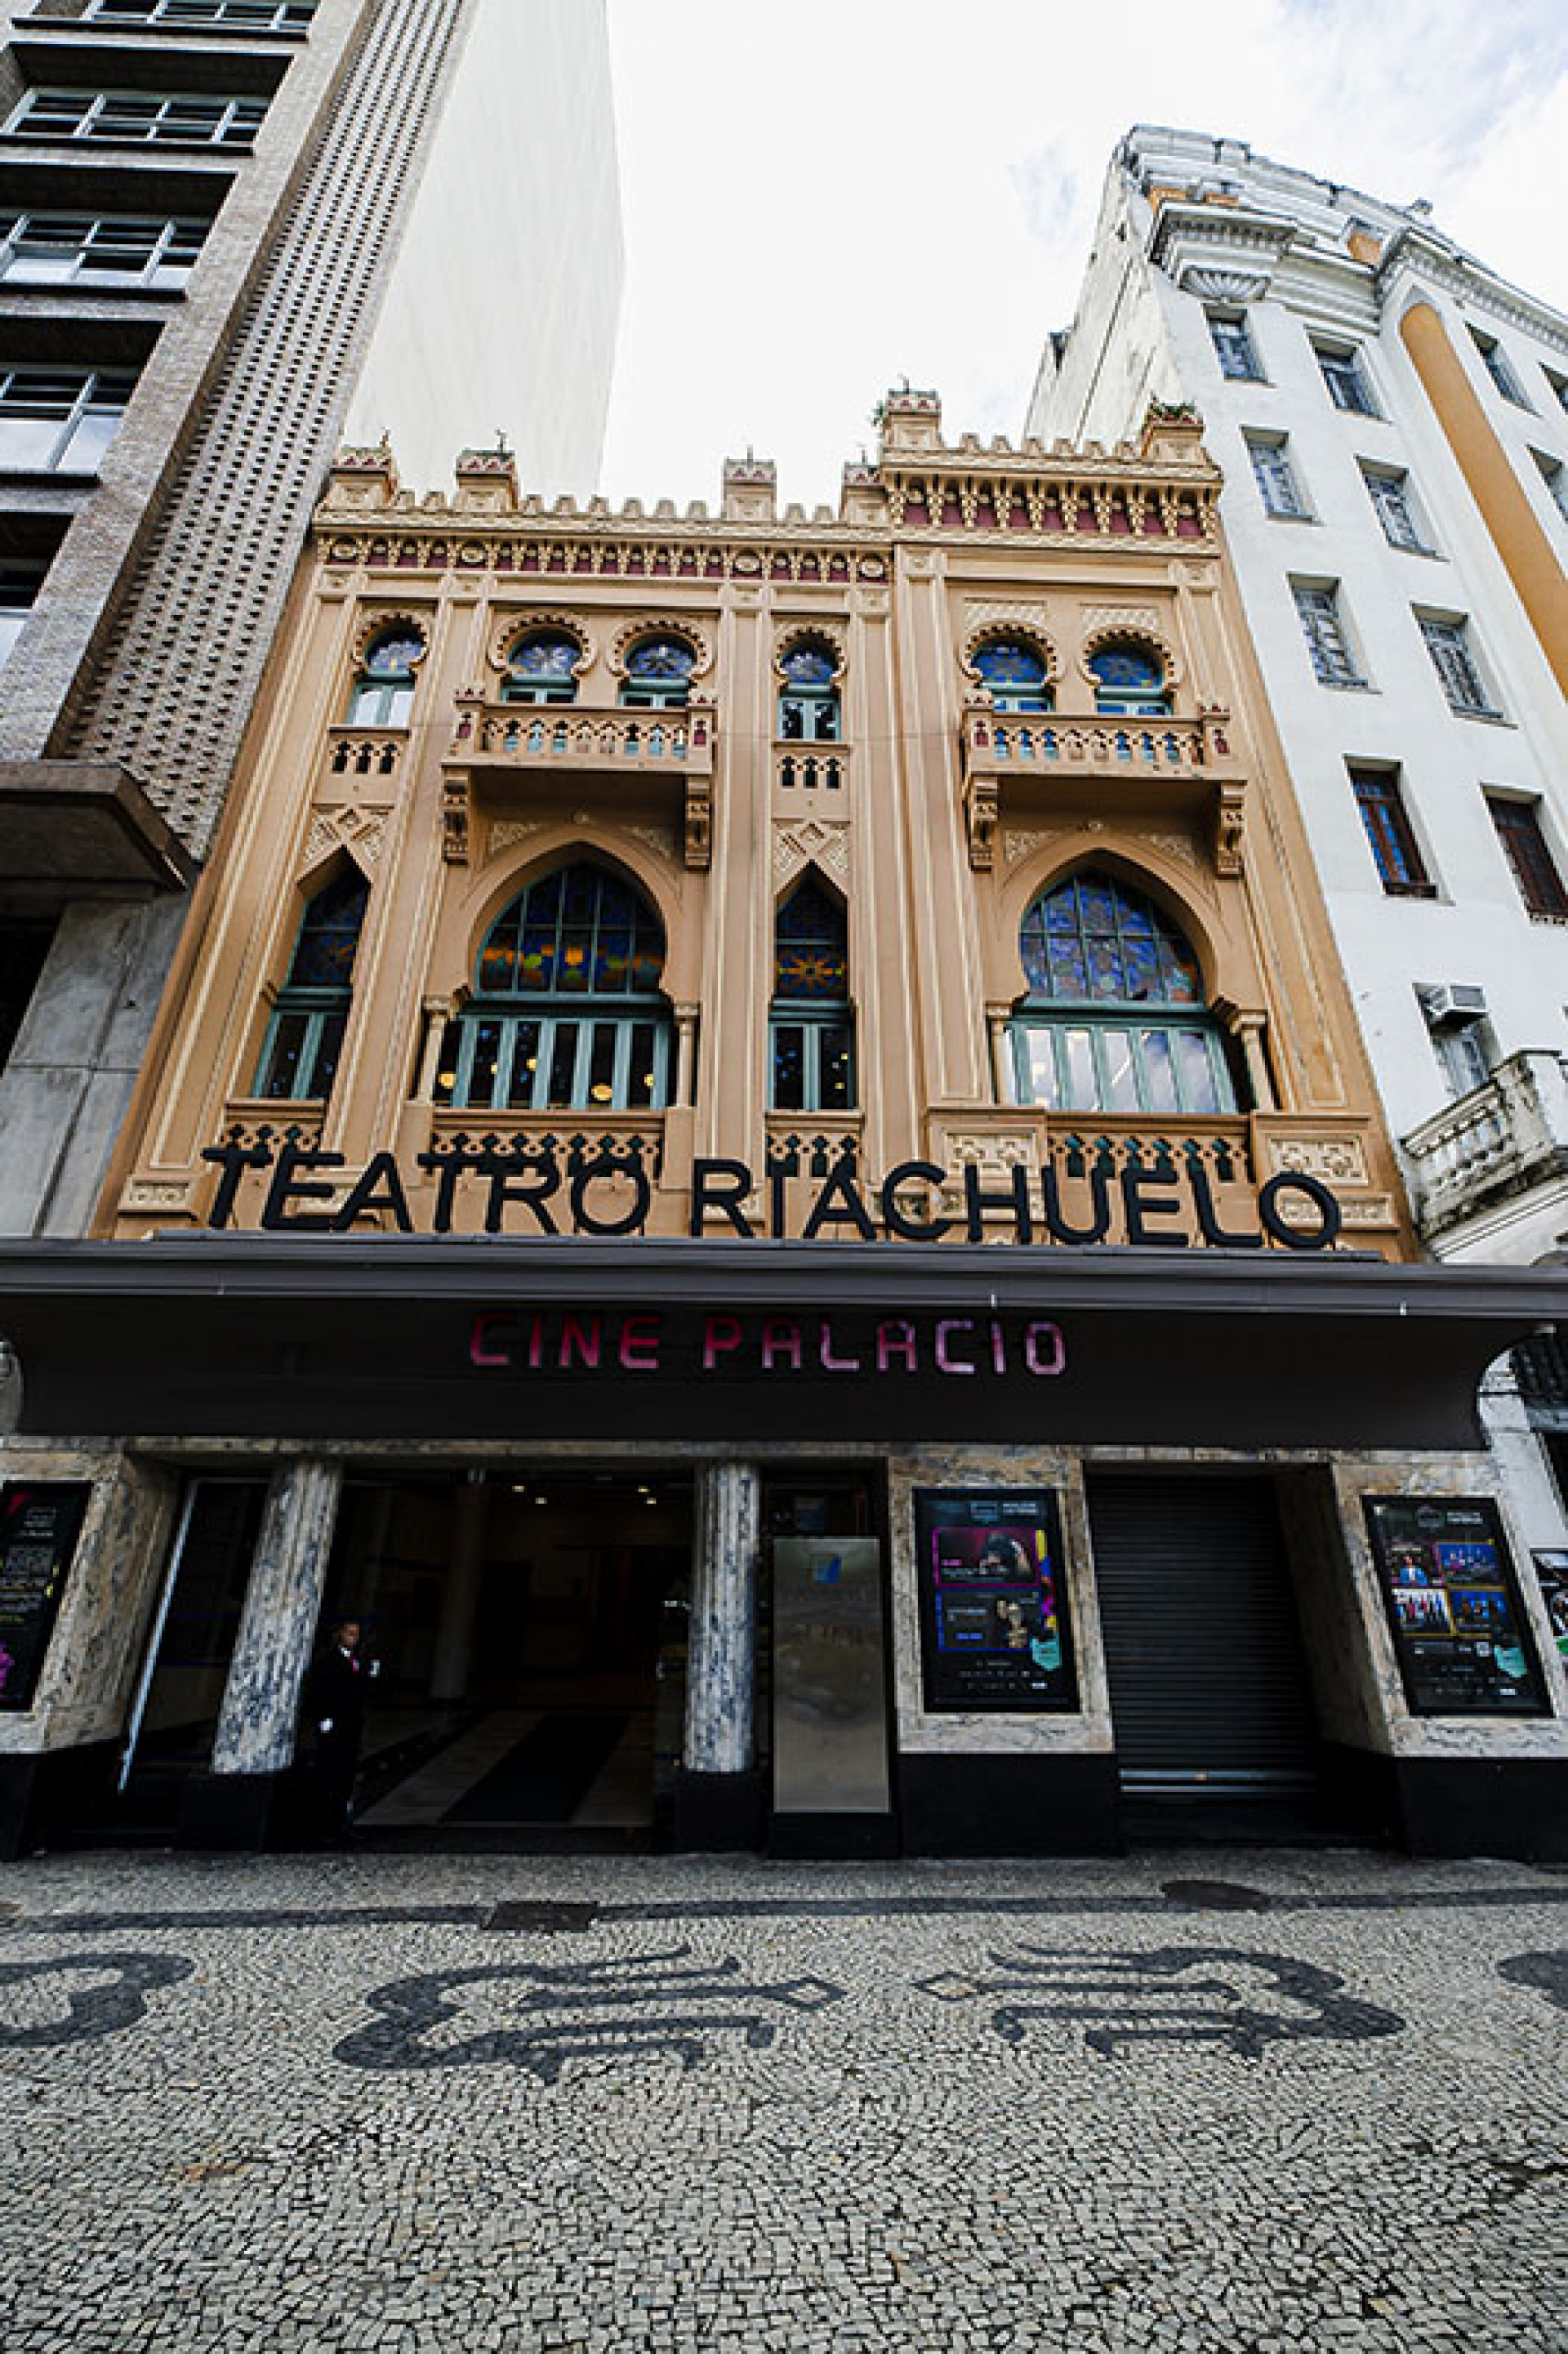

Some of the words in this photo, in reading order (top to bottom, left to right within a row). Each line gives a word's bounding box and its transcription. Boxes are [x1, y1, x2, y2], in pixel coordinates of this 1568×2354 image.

[201, 1147, 652, 1236] TEATRO
[690, 1157, 1342, 1251] RIACHUELO
[470, 1313, 660, 1370] CINE
[702, 1316, 1066, 1375] PALACIO
